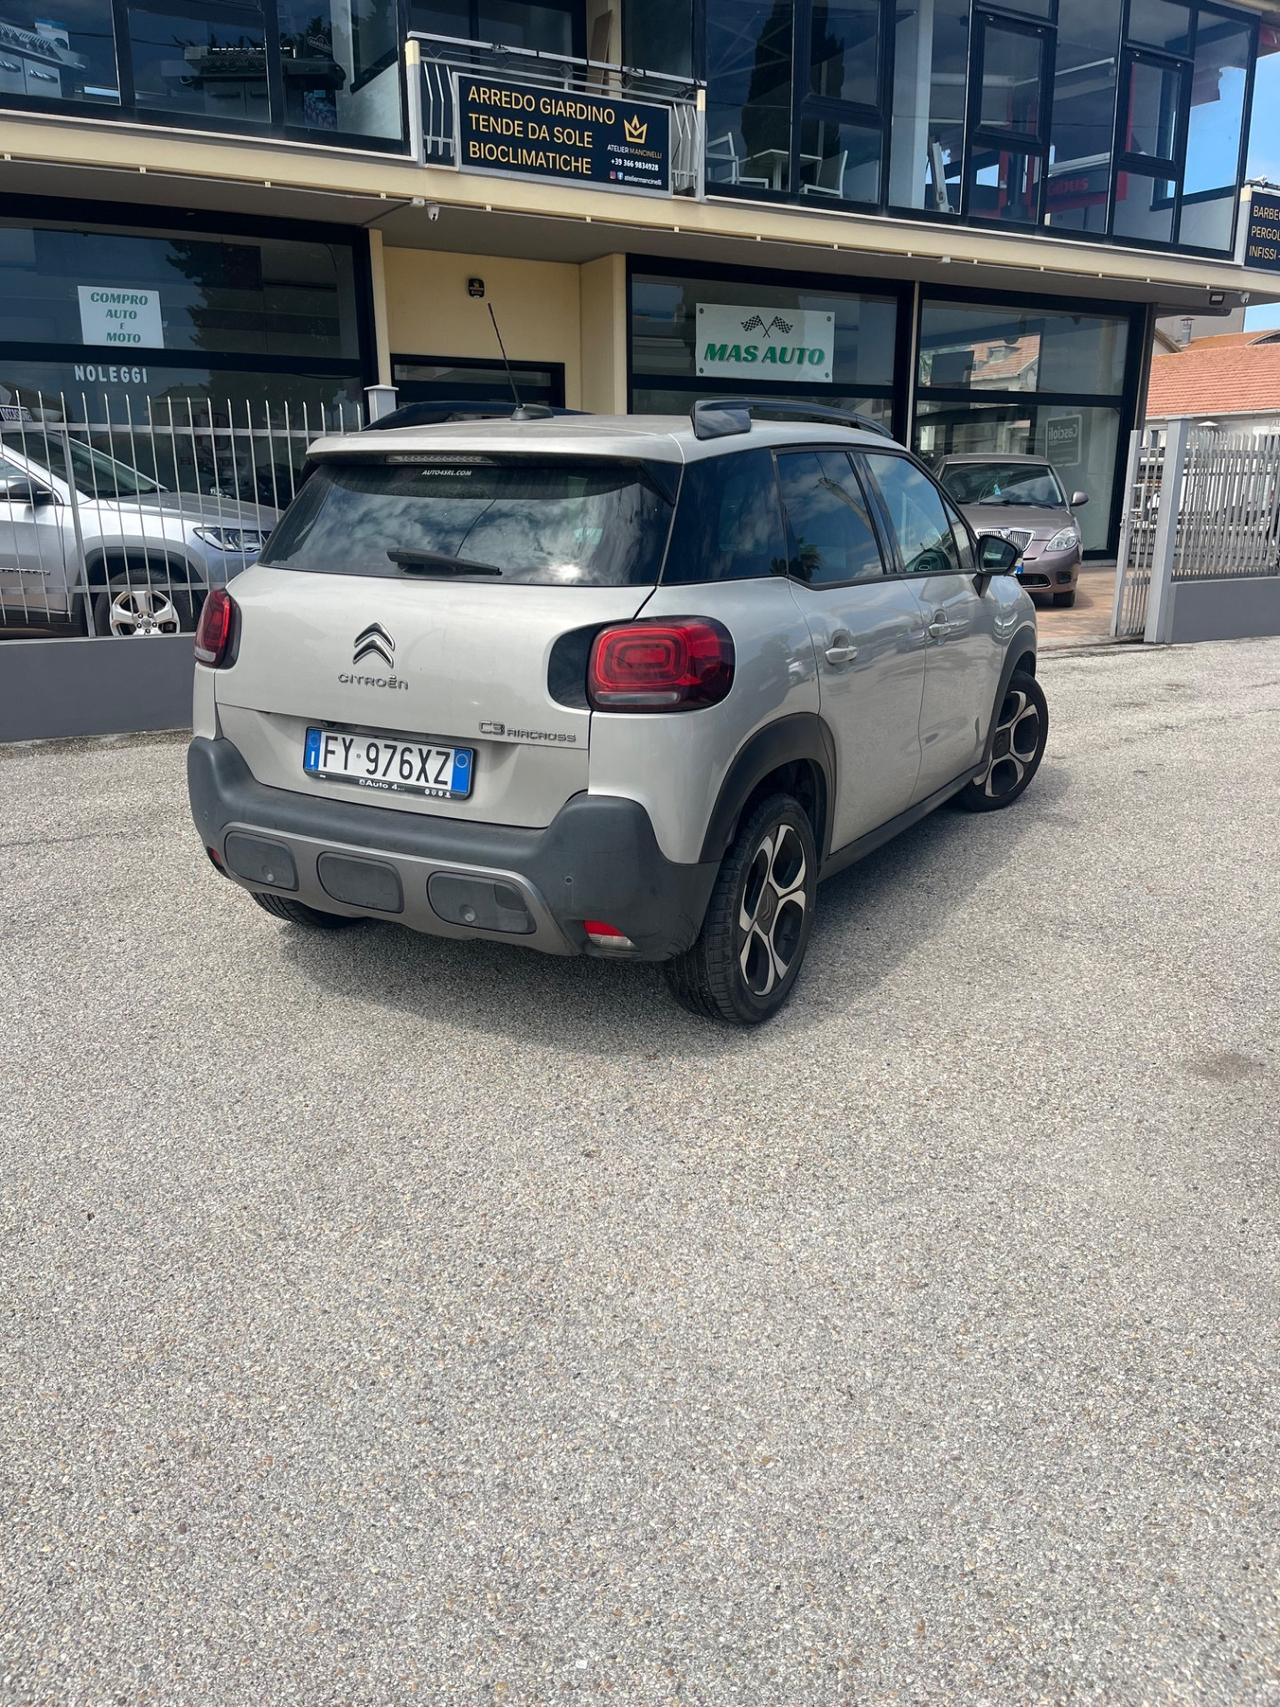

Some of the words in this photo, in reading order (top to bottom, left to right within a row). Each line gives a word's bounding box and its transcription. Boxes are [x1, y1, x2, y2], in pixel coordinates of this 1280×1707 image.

[468, 85, 535, 112] ARREDO
[540, 97, 616, 125] GIARDINO
[468, 113, 524, 138] TENDE
[528, 123, 550, 142] DA
[553, 126, 593, 149] SOLE
[607, 144, 629, 154] ATELIER
[469, 141, 593, 174] BIOCLIMATICHE
[611, 157, 622, 166] +39
[623, 158, 634, 168] 366
[1253, 206, 1280, 221] BARBE
[1249, 245, 1277, 260] INFISSI
[90, 292, 149, 306] COMPRO
[105, 309, 138, 320] AUTO
[120, 322, 126, 330] E
[106, 332, 142, 344] MOTO
[704, 343, 759, 363] MAS
[761, 345, 826, 366] AUTO
[74, 365, 148, 384] NOLEGGI
[337, 674, 409, 690] CITROËN
[479, 720, 506, 736] C3
[507, 728, 577, 743] AIRCROSS
[323, 735, 355, 771] FY
[365, 742, 451, 786] 976XZ
[365, 779, 390, 789] Auto
